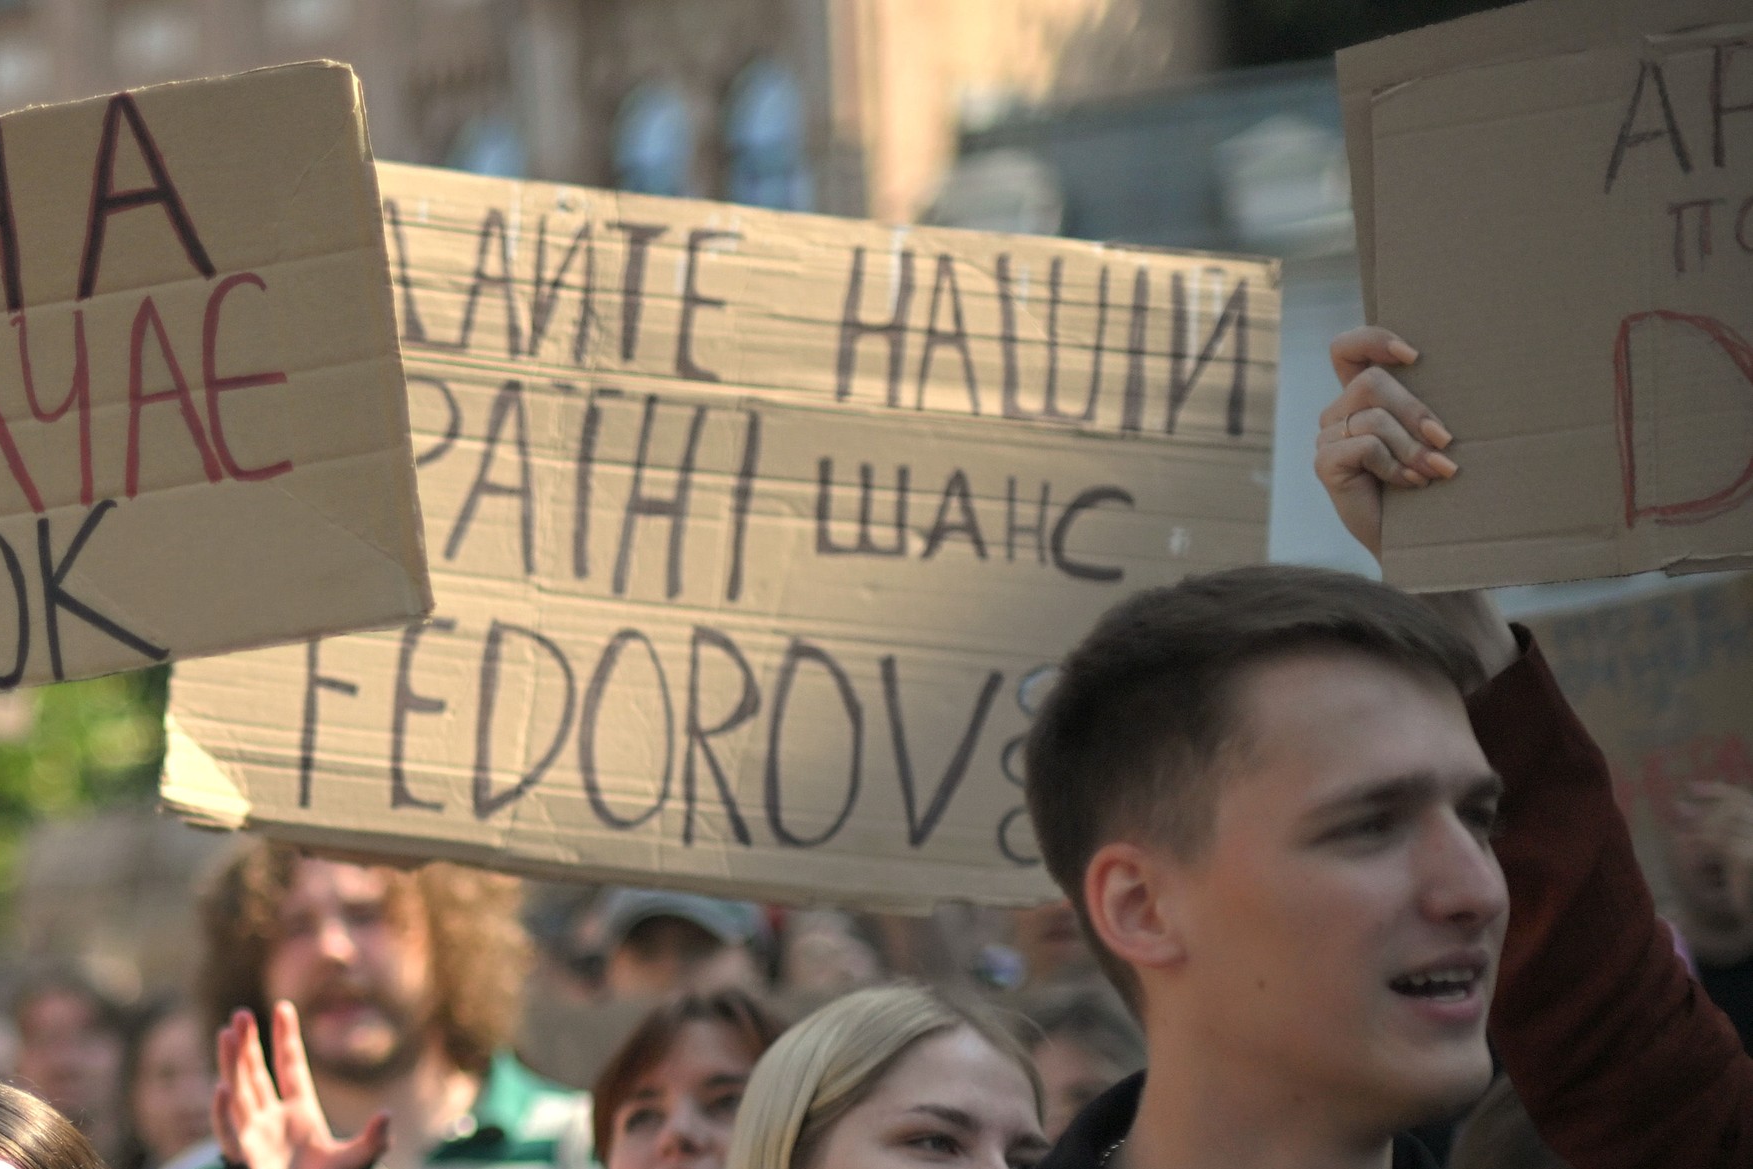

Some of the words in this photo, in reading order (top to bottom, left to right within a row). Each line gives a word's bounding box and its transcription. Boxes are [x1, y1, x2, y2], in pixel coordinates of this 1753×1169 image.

[835, 246, 1250, 438] НАШІЙ
[814, 456, 1136, 583] ШАНС
[296, 615, 1006, 848] FEDOROV
